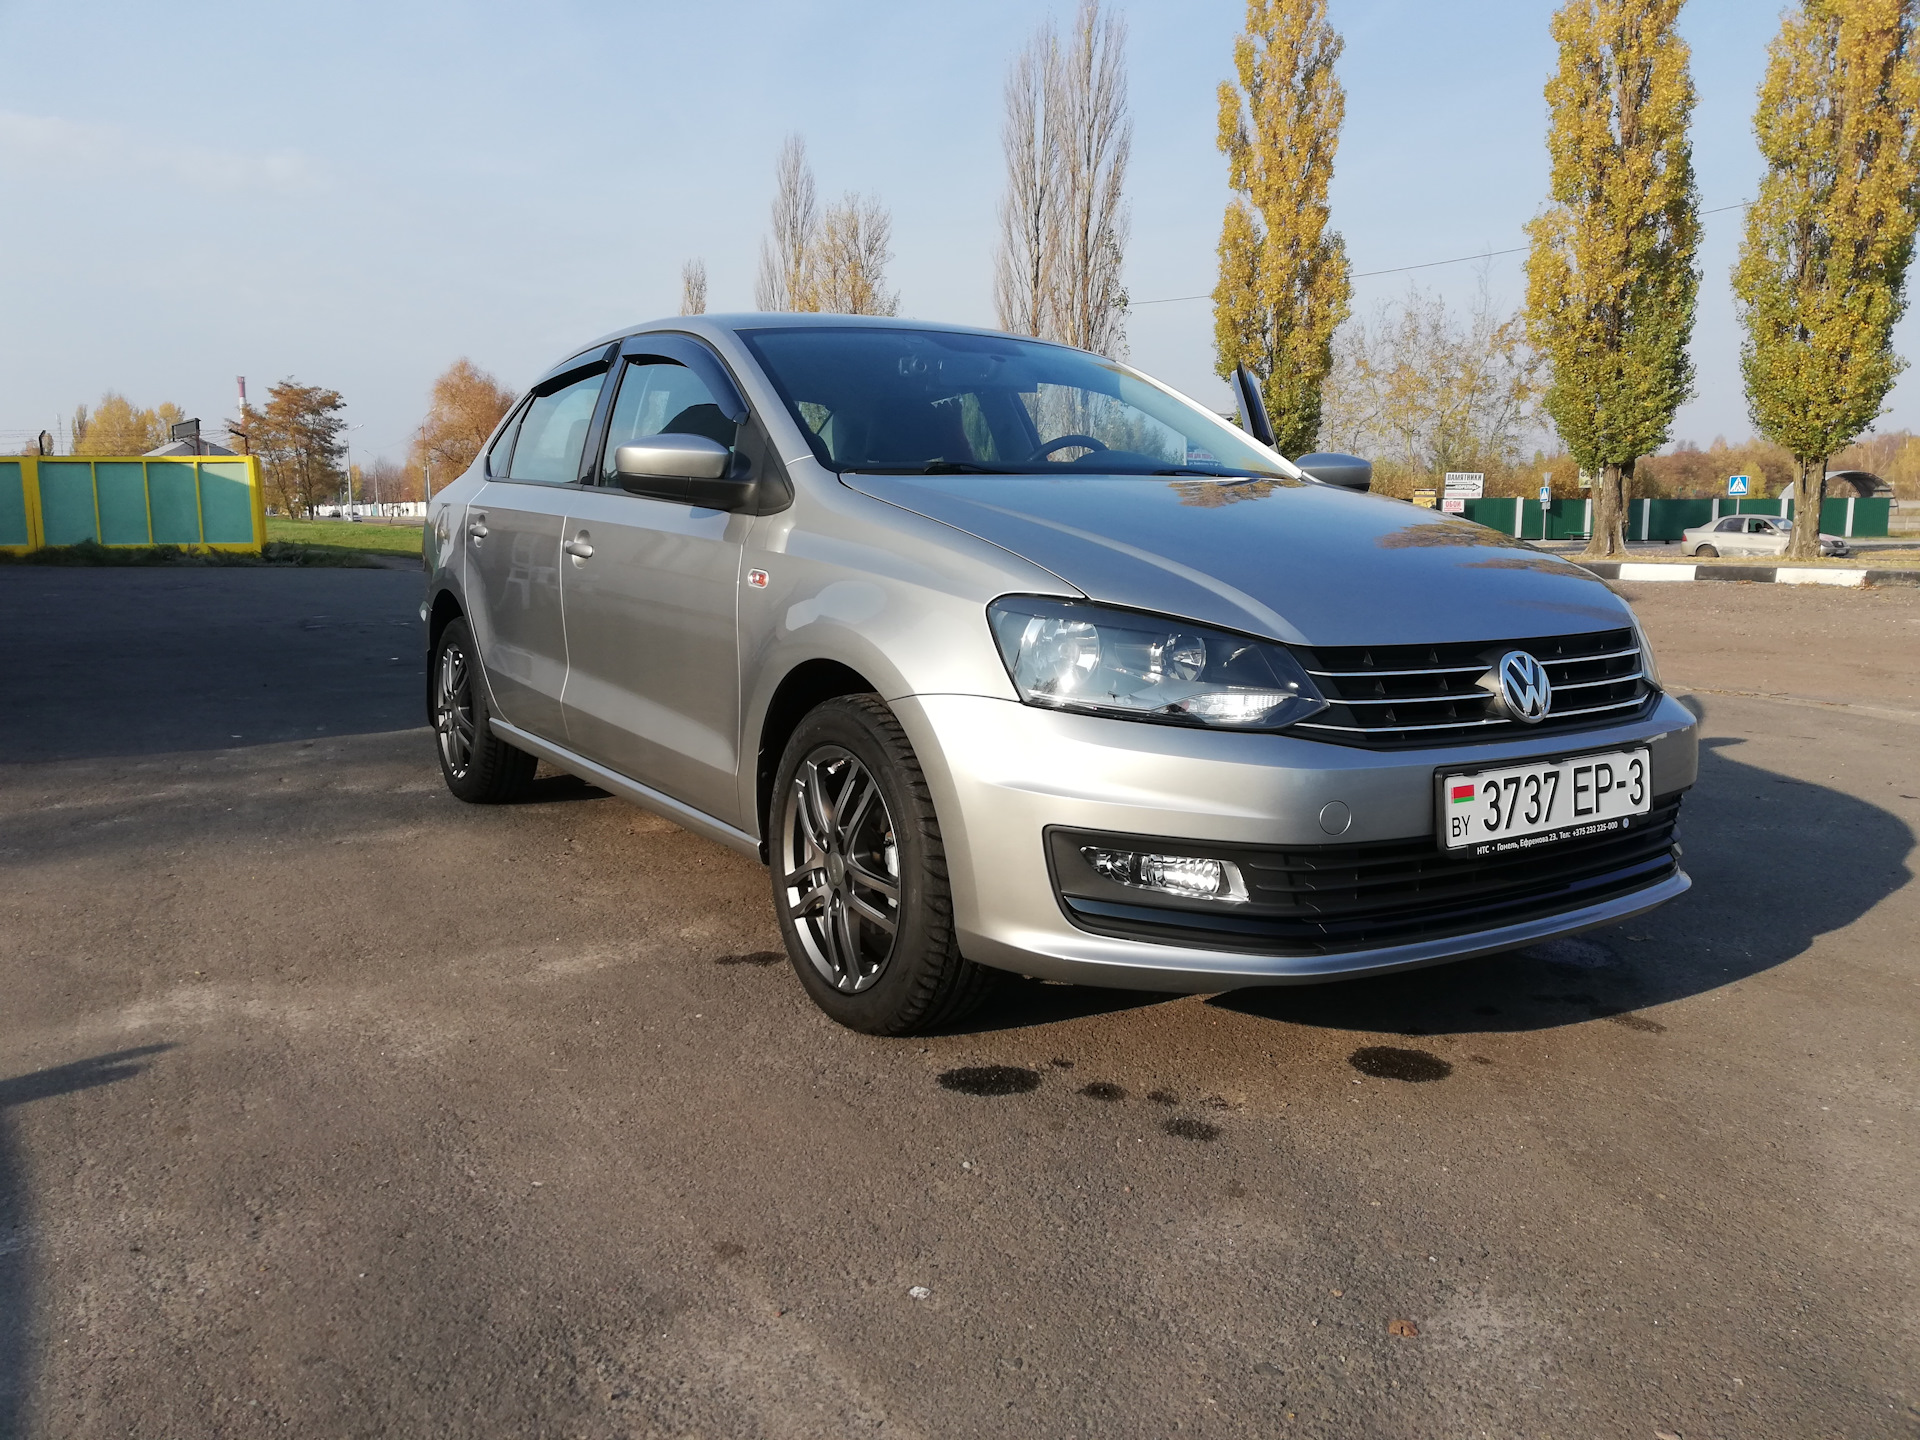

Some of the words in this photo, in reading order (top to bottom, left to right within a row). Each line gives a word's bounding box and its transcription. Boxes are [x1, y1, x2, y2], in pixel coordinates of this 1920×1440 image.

[1482, 770, 1560, 832] 3737
[1573, 758, 1644, 817] EP-3
[1452, 815, 1471, 838] BY
[1476, 845, 1490, 855] НТС
[1572, 827, 1586, 837] +375
[1586, 825, 1596, 834] 232
[1597, 821, 1618, 832] 225-000
